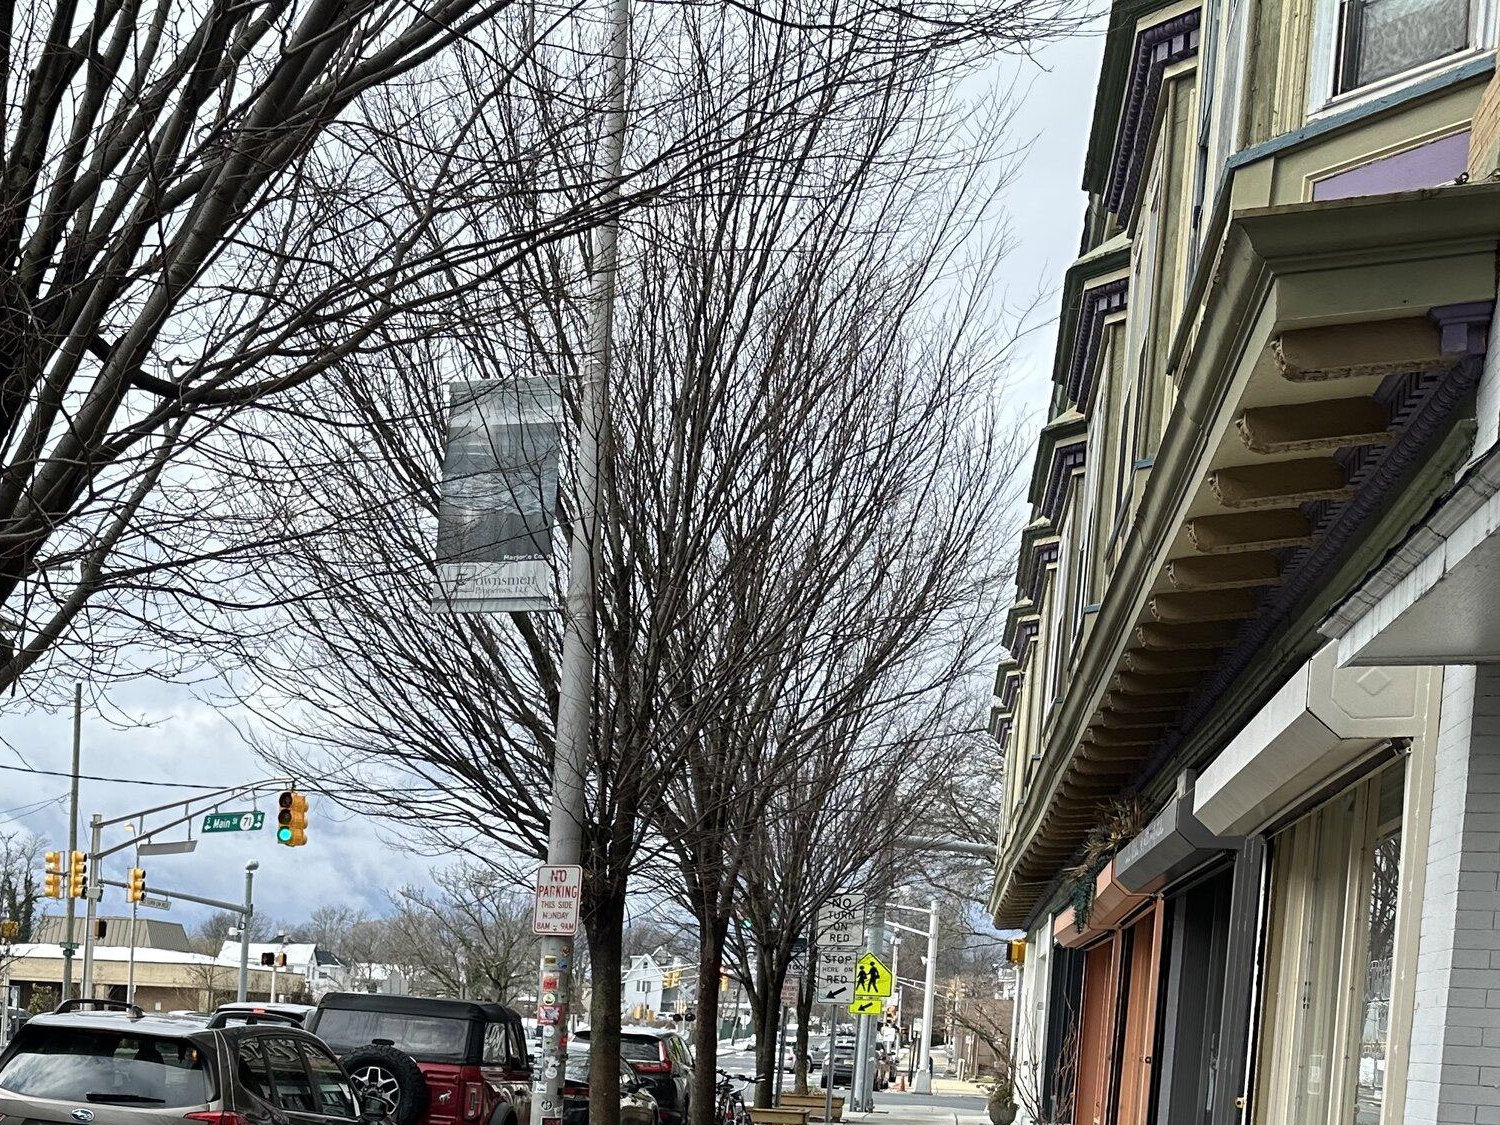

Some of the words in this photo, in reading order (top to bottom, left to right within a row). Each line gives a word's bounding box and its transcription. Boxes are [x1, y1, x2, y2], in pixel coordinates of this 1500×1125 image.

[213, 818, 231, 829] Main
[243, 817, 252, 826] 71
[550, 869, 567, 882] NO
[538, 885, 578, 898] PARKING
[541, 901, 556, 909] THIS
[558, 901, 573, 909] SIDE
[832, 898, 852, 908] NO
[828, 910, 855, 920] TURN
[536, 922, 551, 930] 8AM
[560, 922, 574, 930] 9AM
[833, 922, 847, 931] ON
[829, 933, 850, 942] RED
[825, 955, 852, 964] STOP
[826, 974, 849, 984] RED
